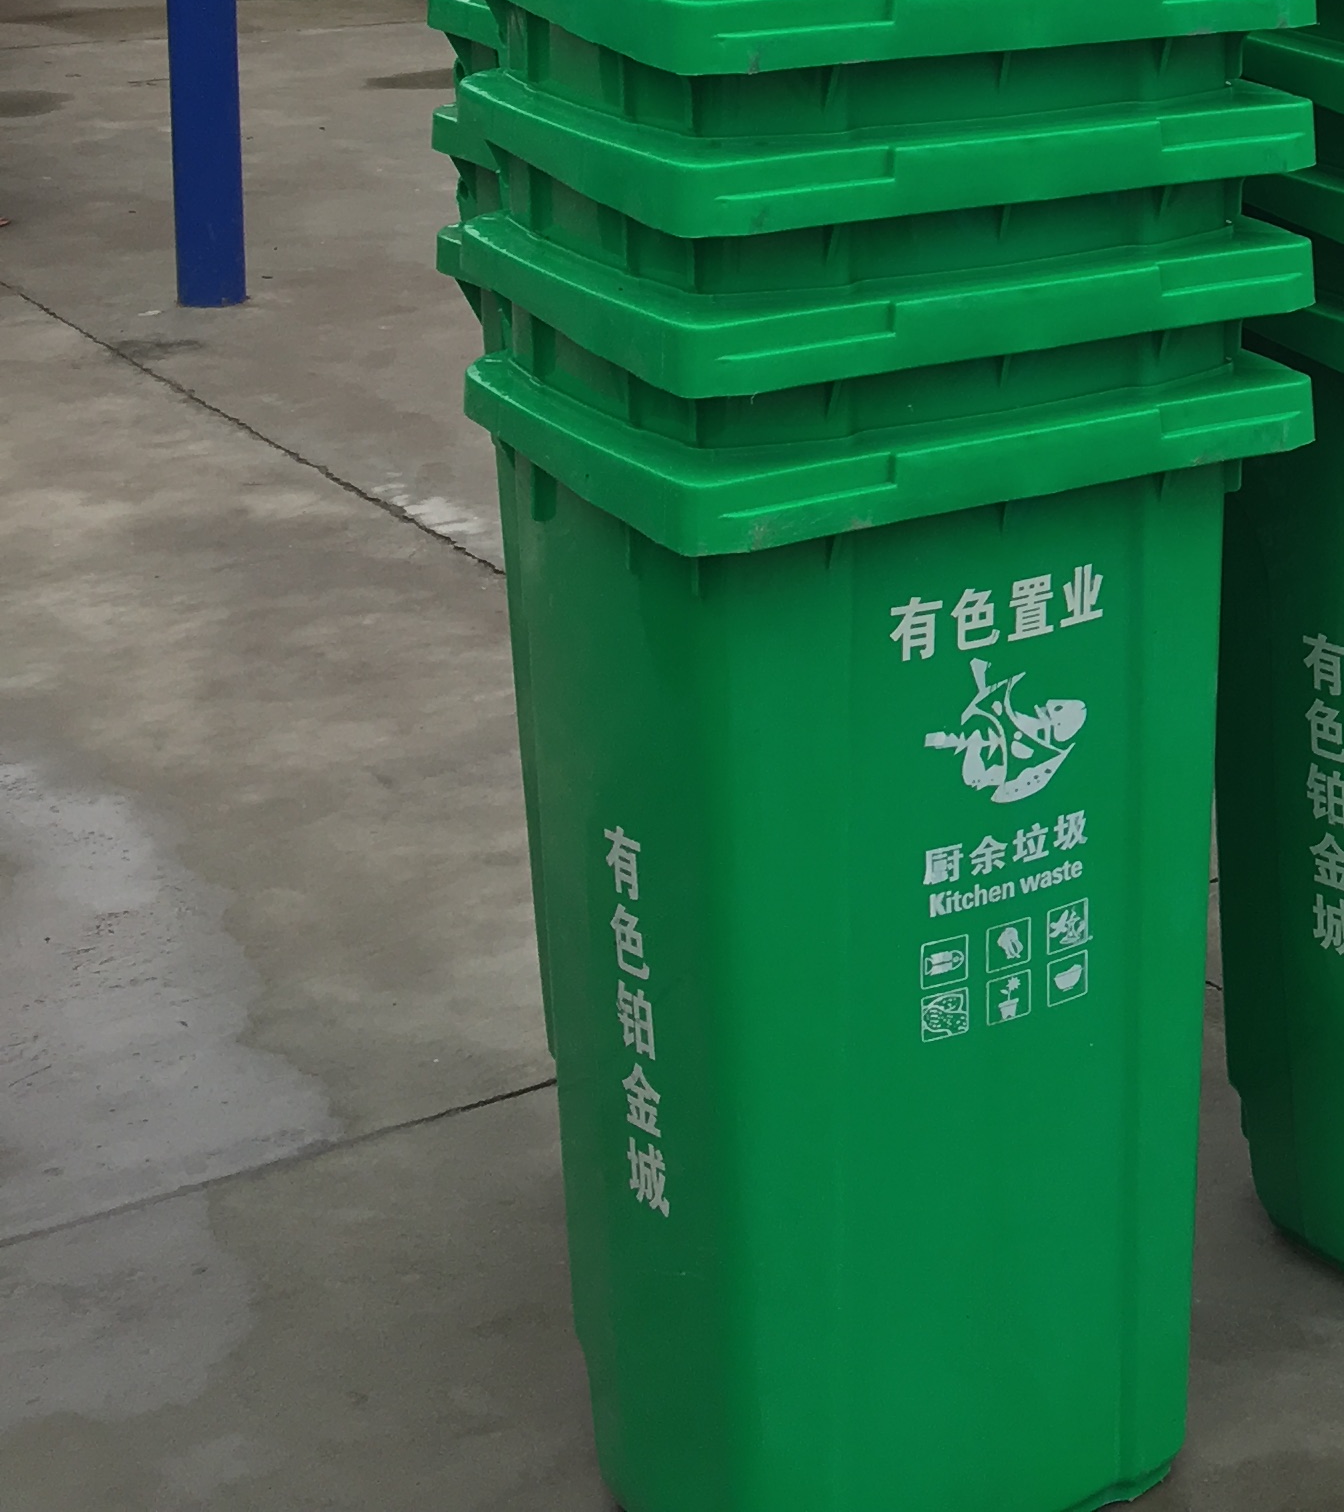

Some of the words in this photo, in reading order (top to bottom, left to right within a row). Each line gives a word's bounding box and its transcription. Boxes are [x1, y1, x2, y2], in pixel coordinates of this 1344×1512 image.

[890, 563, 1104, 662] 有色置业
[923, 809, 1089, 886] 厨余垃圾
[929, 877, 1015, 918] Kitchen
[1019, 860, 1084, 895] waste
[603, 825, 670, 1218] 有色铂金城
